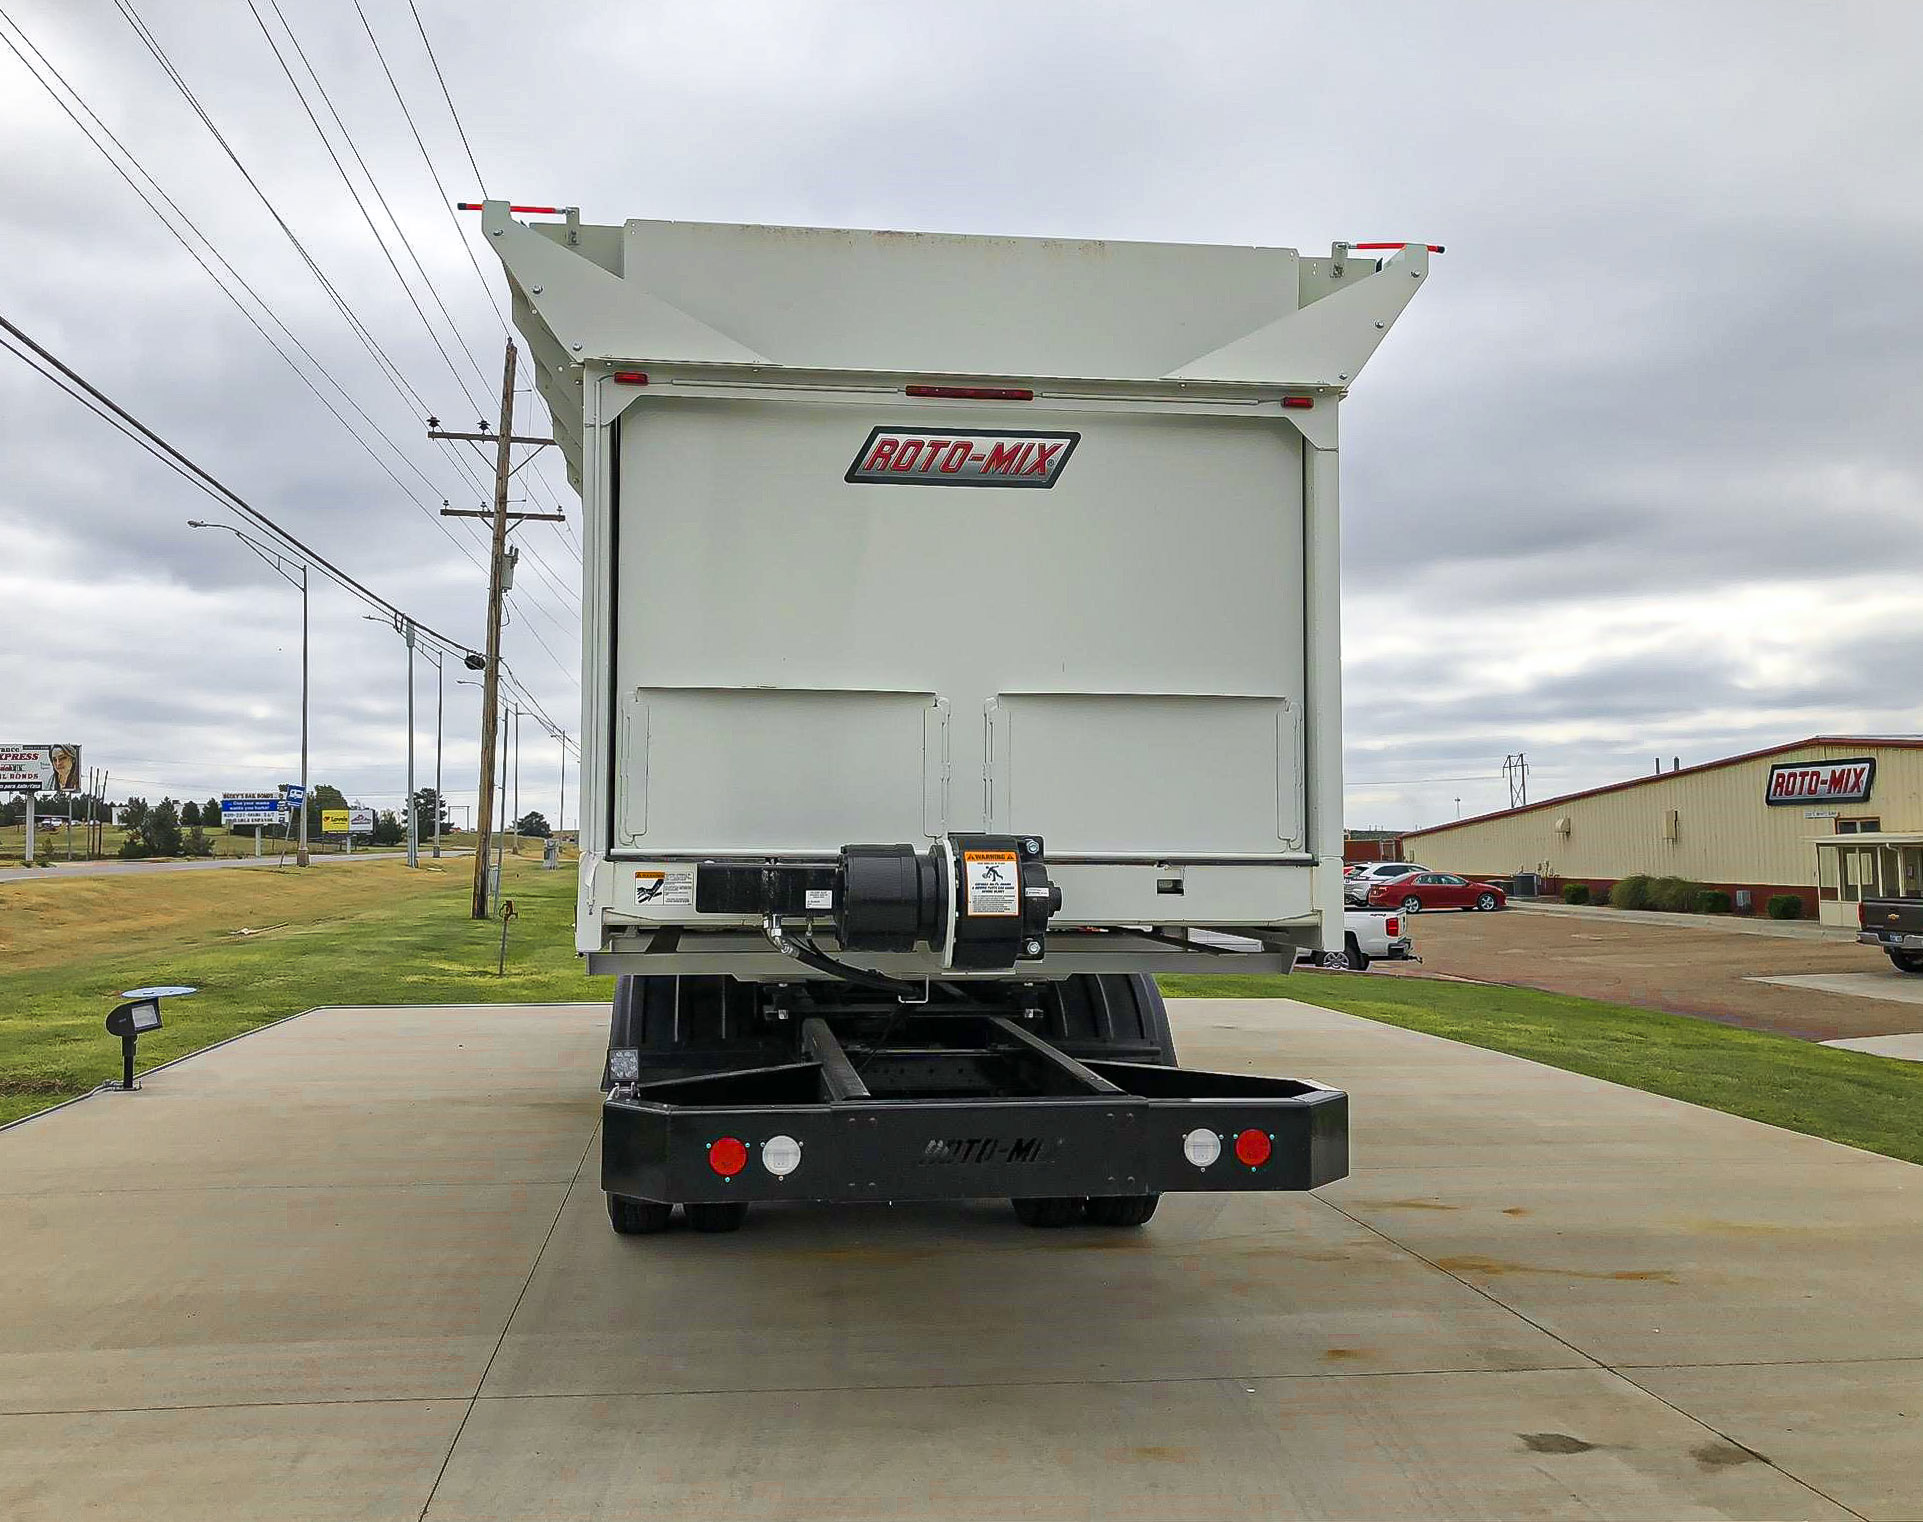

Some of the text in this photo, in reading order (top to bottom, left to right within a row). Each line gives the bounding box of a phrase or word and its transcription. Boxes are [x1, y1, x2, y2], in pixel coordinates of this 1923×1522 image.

[863, 438, 1064, 477] ROTO-MIX
[1772, 767, 1867, 797] ROTO-MIX
[919, 1138, 1062, 1165] ROTO-MI
